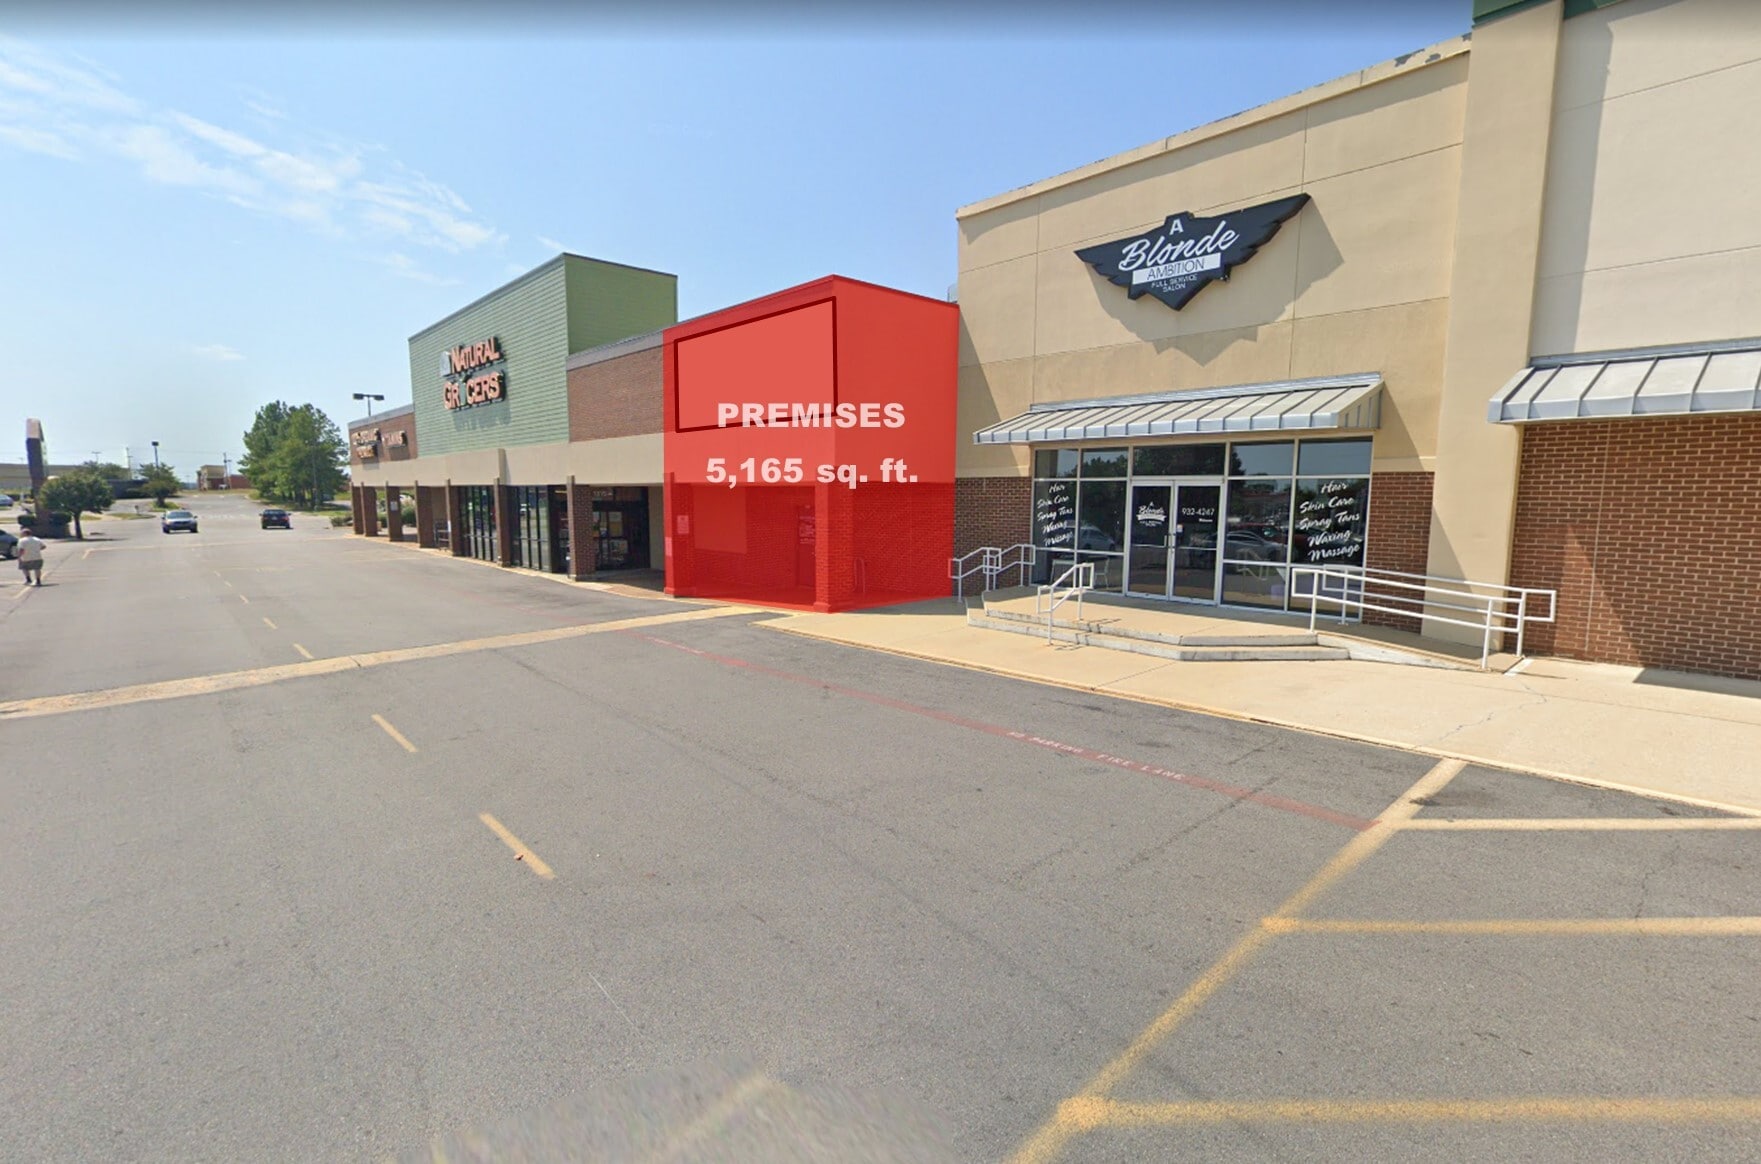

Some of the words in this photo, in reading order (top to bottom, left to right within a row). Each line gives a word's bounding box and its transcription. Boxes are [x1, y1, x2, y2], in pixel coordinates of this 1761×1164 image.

[1169, 219, 1184, 235] A
[1118, 220, 1240, 271] Blonde
[1147, 257, 1205, 281] AMBITION
[1150, 280, 1168, 289] FULL
[1169, 273, 1198, 285] SERVICE
[1162, 283, 1186, 292] SALON
[450, 336, 501, 374] NATURAL
[1320, 480, 1348, 494] Hair
[1299, 500, 1325, 514] Skin
[1328, 495, 1354, 508] Care
[1299, 517, 1332, 531] Spray
[1334, 510, 1360, 524] Tans
[1307, 529, 1352, 547] Waxing
[1307, 543, 1360, 562] Massage
[1096, 753, 1134, 767] FIRE
[1140, 765, 1186, 781] LANE
